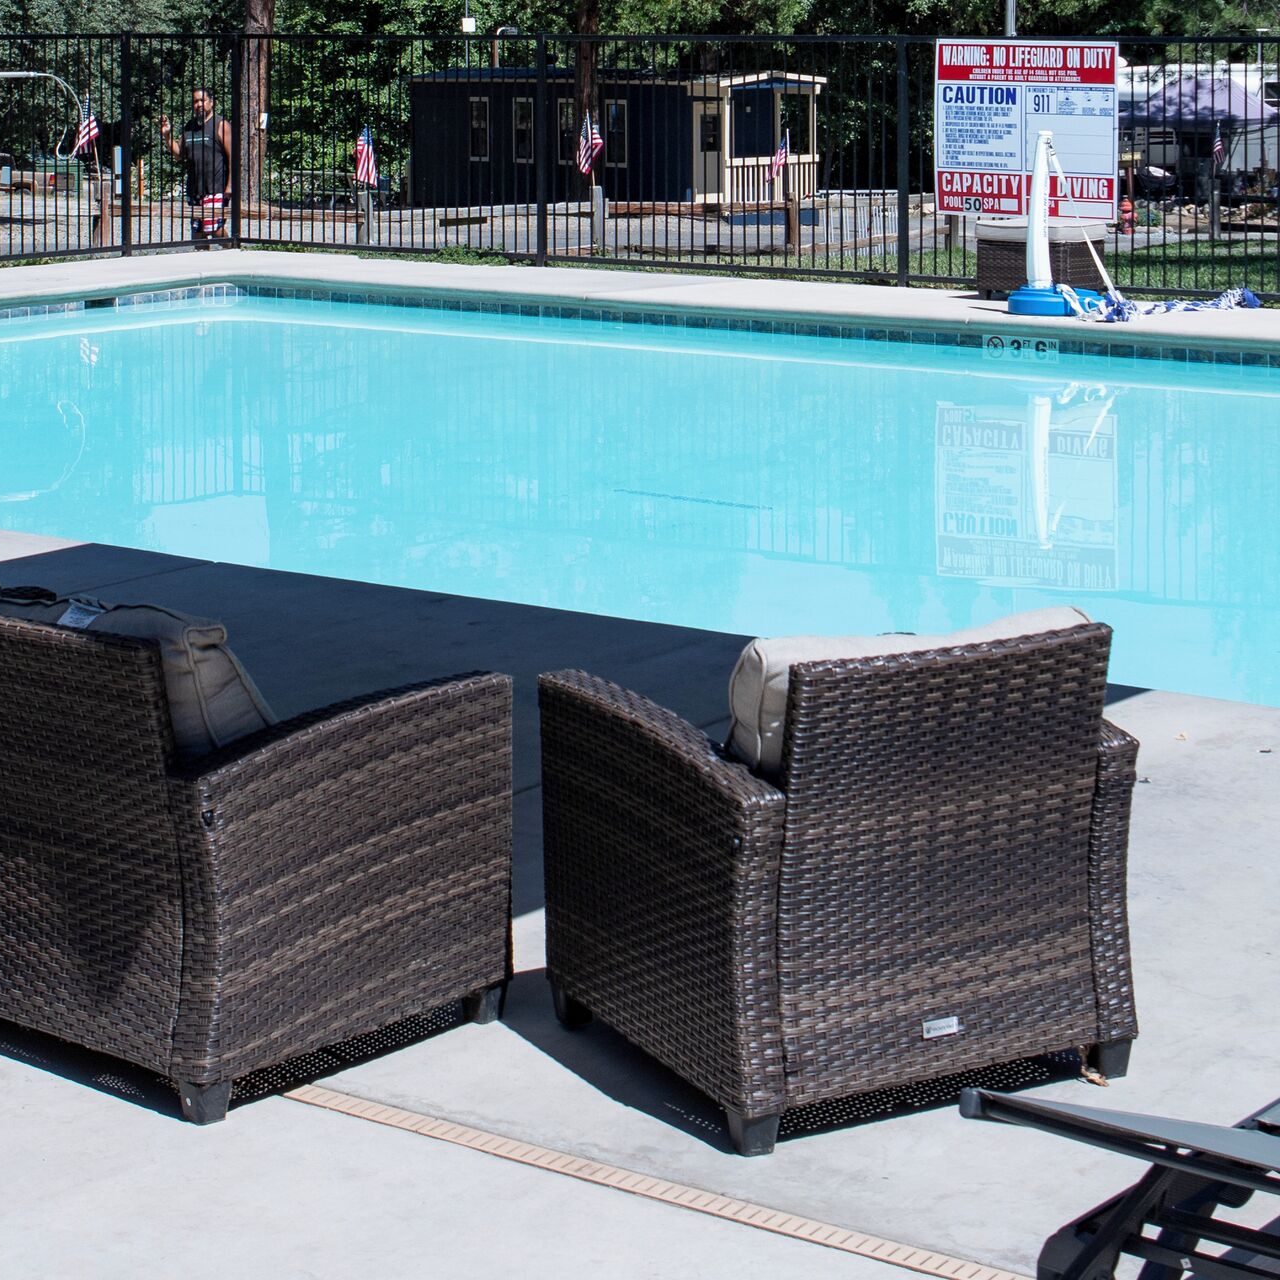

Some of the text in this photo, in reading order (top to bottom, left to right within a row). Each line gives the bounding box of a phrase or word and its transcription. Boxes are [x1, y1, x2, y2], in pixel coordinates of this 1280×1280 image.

[942, 46, 1111, 69] WARNING: NO LIFEGUARD ON DUTY
[942, 86, 1016, 105] CAUTION
[1034, 95, 1050, 112] 911
[942, 173, 1019, 195] CAPACITY
[944, 196, 999, 211] POOL 50 SPA
[1023, 340, 1031, 348] FT
[1049, 341, 1056, 349] IN
